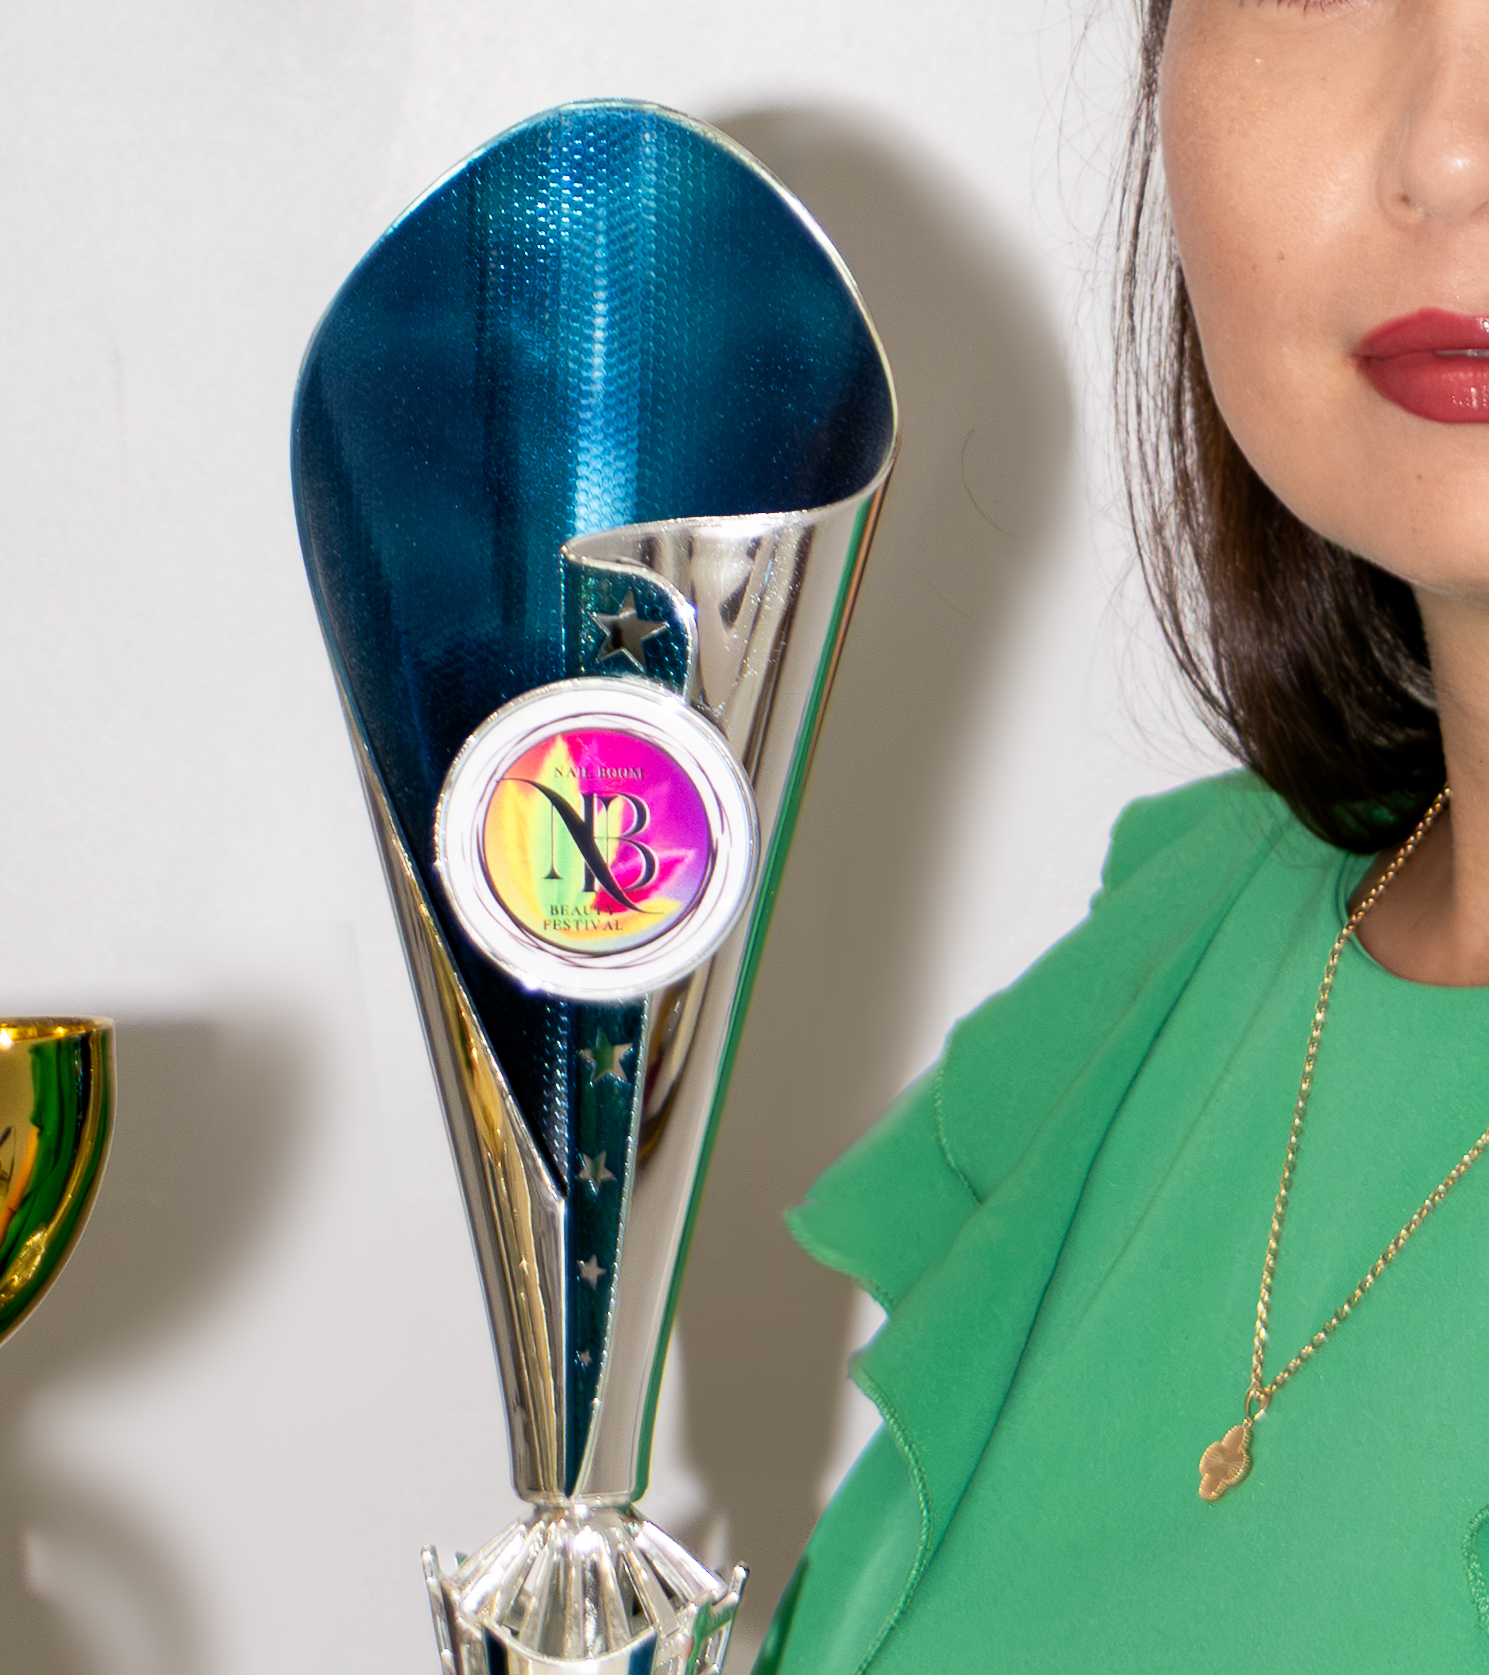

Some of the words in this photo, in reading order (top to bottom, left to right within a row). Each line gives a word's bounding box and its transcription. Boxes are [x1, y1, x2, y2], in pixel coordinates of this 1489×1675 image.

[553, 766, 590, 779] NAIL
[549, 904, 615, 917] BEAUTY
[543, 919, 624, 931] FESTIVAL
